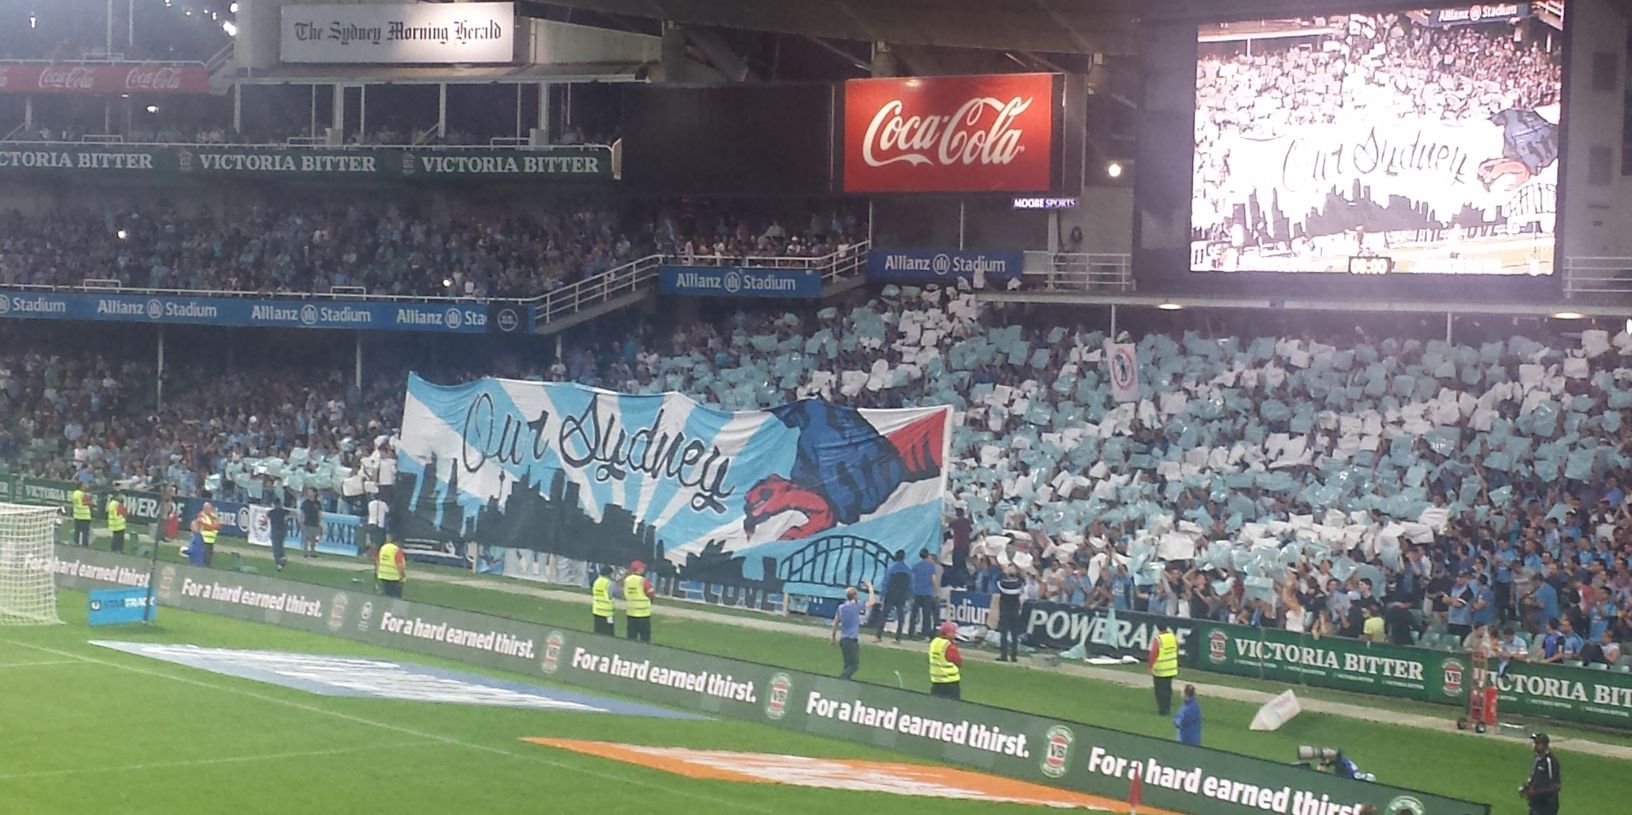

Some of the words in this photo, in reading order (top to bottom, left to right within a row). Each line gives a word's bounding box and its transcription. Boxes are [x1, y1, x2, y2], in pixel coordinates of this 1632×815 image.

[294, 22, 323, 42] The
[328, 21, 381, 45] Sydney
[387, 21, 449, 45] Morning
[454, 20, 502, 45] Herald
[863, 96, 1033, 167] Coca-Cola
[78, 153, 153, 169] BITTER
[199, 153, 297, 171] VICTORIA
[301, 155, 376, 172] BITTER
[421, 156, 519, 173] VICTORIA
[524, 156, 599, 174] BITTER
[1045, 198, 1076, 208] SPORTS
[884, 254, 930, 271] Allianz
[953, 256, 1006, 273] Stadium
[676, 273, 722, 288] Allianz
[743, 274, 796, 291] Stadium
[13, 297, 66, 314] Stadium
[97, 299, 144, 315] Allianz
[165, 302, 217, 318] Stadium
[251, 305, 298, 321] Allianz
[321, 306, 371, 322] Stadium
[396, 309, 443, 325] Allianz
[464, 311, 487, 325] Sta
[462, 392, 549, 473] Our
[559, 391, 737, 515] Sydney
[25, 485, 66, 501] VICTORIA
[54, 557, 80, 576] hard
[79, 563, 118, 582] earned
[182, 578, 202, 596] For
[203, 585, 212, 599] a
[212, 582, 242, 604] hard
[241, 591, 286, 613] earned
[285, 595, 323, 618] thirst.
[380, 611, 403, 631] For
[403, 619, 414, 633] a
[413, 617, 447, 642] hard
[446, 627, 495, 650] earned
[494, 631, 535, 659] thirst.
[1026, 608, 1193, 656] POWERAE
[1235, 638, 1340, 670] VICTORIA
[1344, 653, 1424, 681] BITTER
[572, 646, 599, 670] For
[599, 657, 610, 673] a
[610, 654, 650, 682] hard
[649, 665, 707, 693] earned
[707, 673, 757, 704] thirst.
[805, 691, 839, 717] For
[838, 703, 851, 721] a
[851, 701, 899, 730] hard
[898, 713, 969, 745] earned
[968, 723, 1030, 759] thirst.
[1087, 746, 1128, 777] For
[1144, 757, 1203, 794] hard
[1202, 773, 1291, 814] earned
